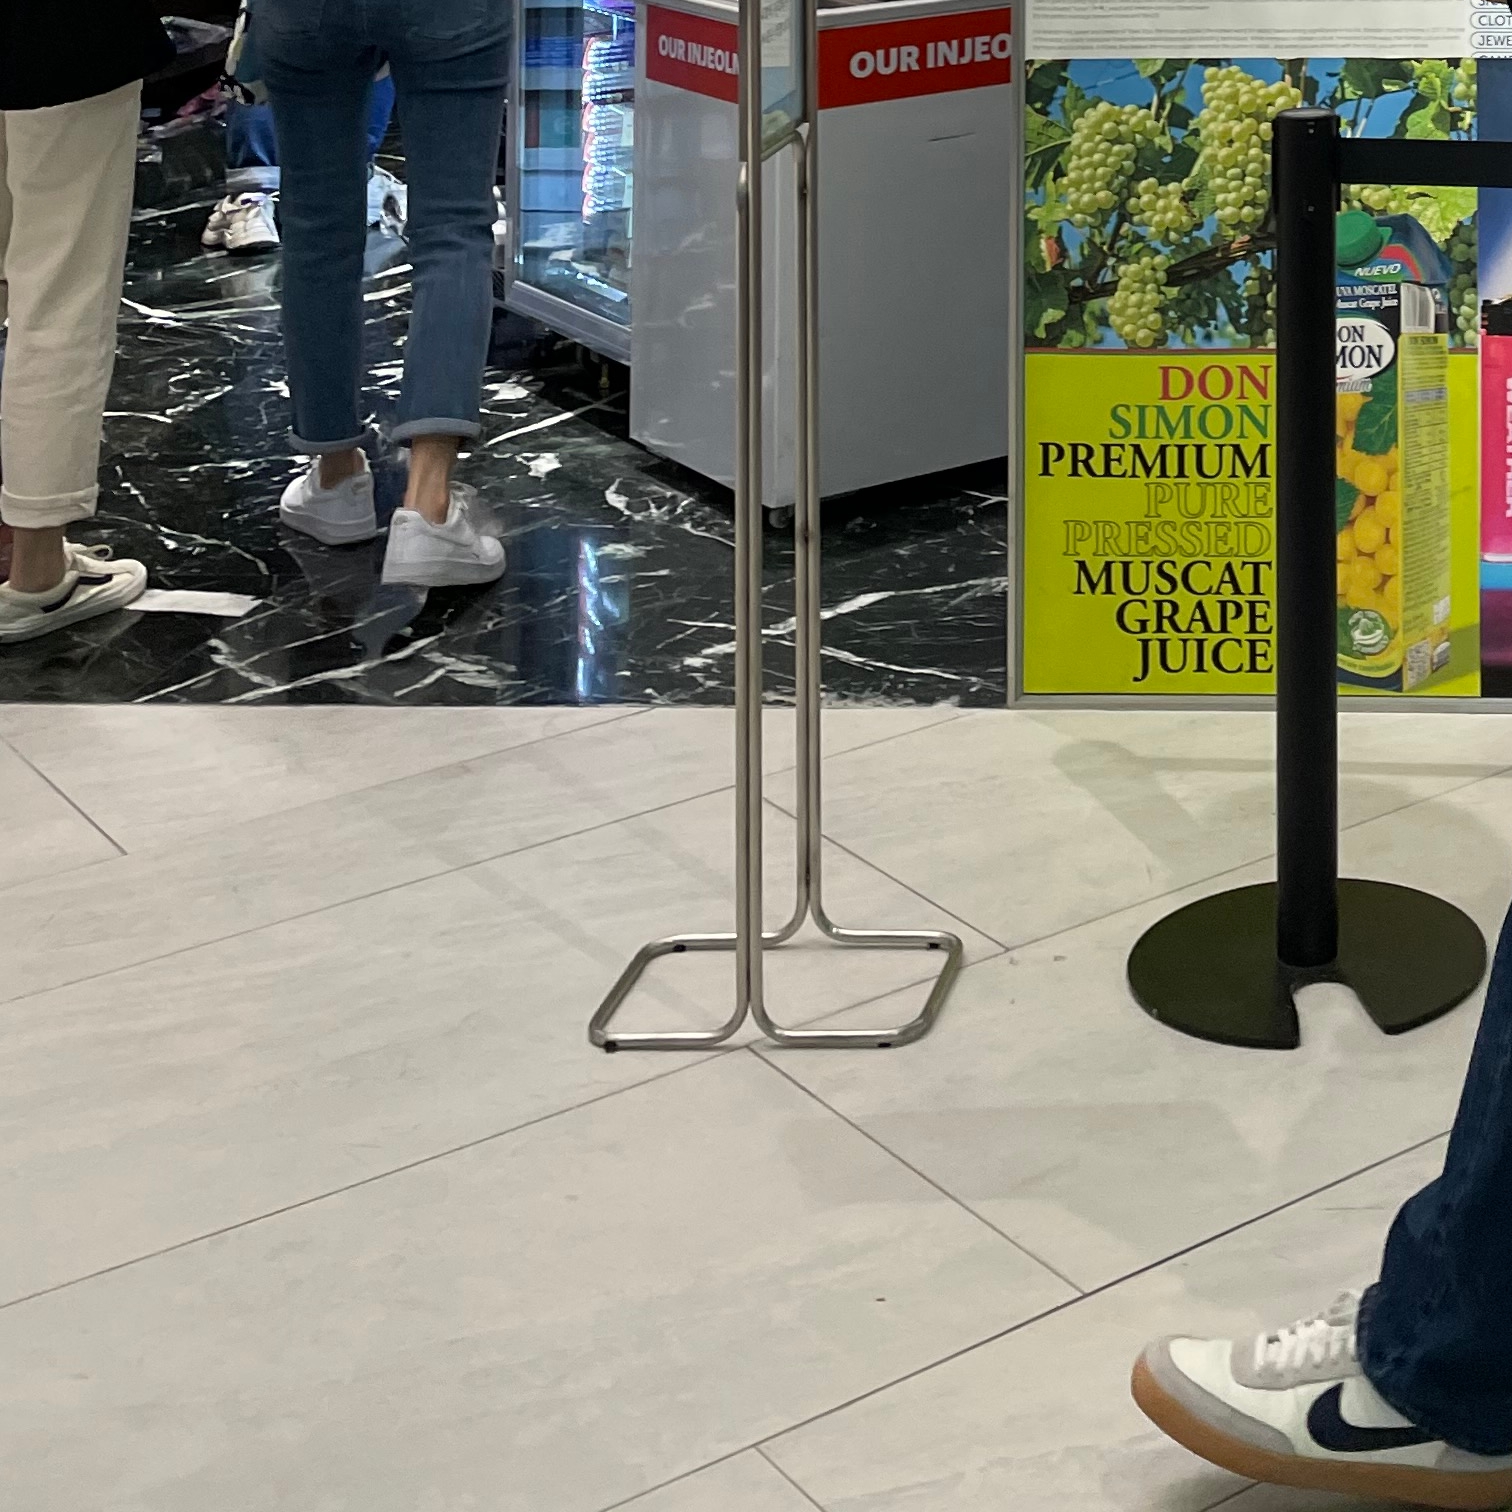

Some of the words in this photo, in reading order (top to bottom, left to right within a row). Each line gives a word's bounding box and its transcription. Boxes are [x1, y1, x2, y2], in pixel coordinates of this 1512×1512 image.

[658, 34, 686, 60] OUR
[849, 44, 920, 79] OUR
[1354, 263, 1401, 277] NUEVO
[1337, 325, 1365, 343] ON
[1336, 345, 1384, 368] MON
[1158, 365, 1273, 401] DON
[1109, 404, 1273, 440] SIMON
[1038, 442, 1272, 479] PREMIUM
[1144, 482, 1273, 519] PURE
[1062, 519, 1272, 558] PRESSED
[1073, 560, 1273, 596] MUSCAT
[1115, 599, 1273, 635] GRAPE
[1132, 637, 1273, 682] JUICE
